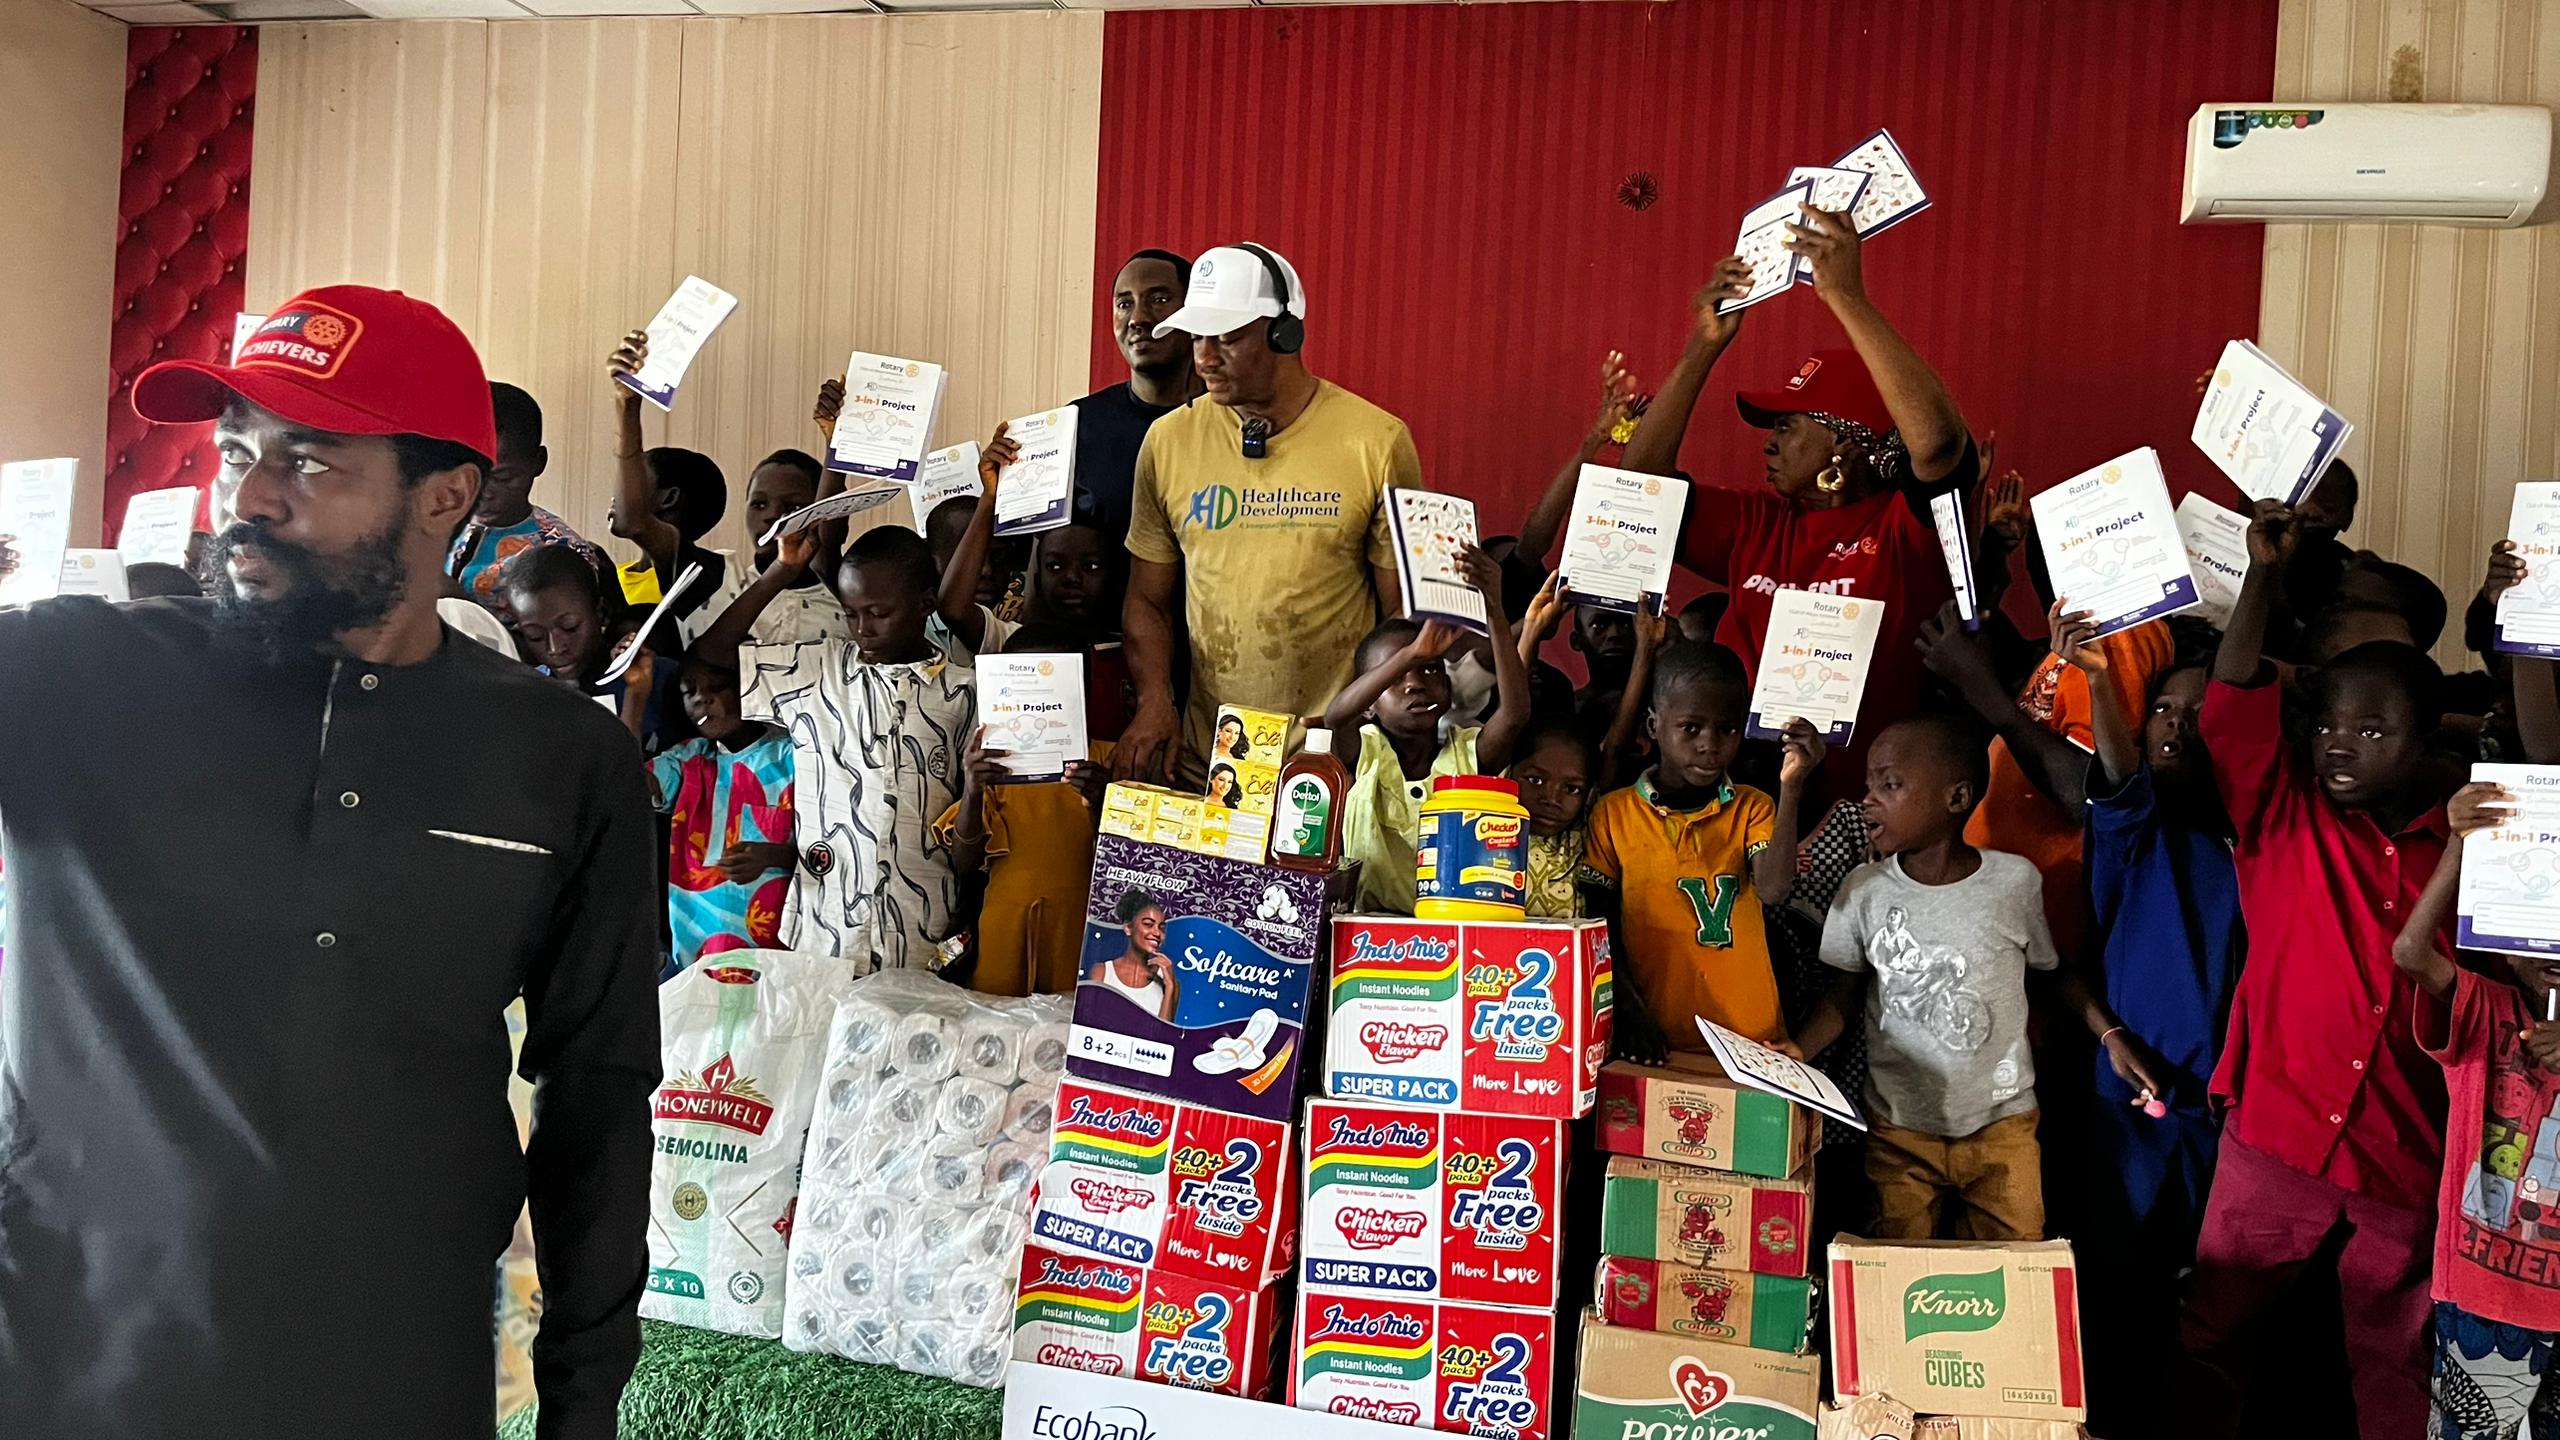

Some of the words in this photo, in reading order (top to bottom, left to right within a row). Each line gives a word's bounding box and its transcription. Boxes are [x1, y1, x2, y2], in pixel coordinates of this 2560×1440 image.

[240, 340, 330, 366] ACHIEVERS
[880, 362, 904, 373] Rotary
[854, 395, 880, 406] 3-in-1
[881, 399, 916, 412] Project
[2240, 388, 2266, 430] Project
[1025, 418, 1045, 429] Rotary
[926, 455, 947, 465] Rotary
[1030, 449, 1059, 462] Project
[1615, 476, 1643, 490] Rotary
[2068, 477, 2100, 497] Rotary
[921, 491, 942, 503] 3-in-1
[943, 483, 974, 497] Project
[1242, 487, 1341, 504] Healthcare
[1240, 503, 1339, 519] Development
[1586, 515, 1616, 528] 3-in-1
[1617, 520, 1657, 535] Project
[2059, 531, 2094, 552] 3-in-1
[2095, 511, 2145, 537] Project
[2522, 544, 2554, 556] 3-in-1
[2203, 555, 2243, 579] Project
[1813, 601, 1841, 615] Rotary
[1781, 645, 1812, 657] 3-in-1
[1813, 648, 1853, 662] Project
[1009, 664, 1036, 673] Rotary
[992, 703, 1020, 713] 3-in-1
[1023, 702, 1063, 712] Project
[2489, 831, 2534, 843] 3-in-1
[812, 850, 828, 867] 79
[1107, 865, 1149, 886] HEAVY
[1149, 874, 1188, 892] FLOW
[1677, 874, 1738, 948] V
[1244, 918, 1280, 934] COTTON
[1281, 925, 1303, 938] FEEL
[1177, 945, 1280, 986] Softcare
[1512, 951, 1552, 998] 2
[1219, 979, 1257, 998] Sanitary
[1258, 987, 1278, 1000] Pad
[1359, 983, 1391, 995] Instant
[1392, 984, 1430, 997] Noodles
[1468, 983, 1499, 995] packs
[1507, 998, 1549, 1011] packs
[1473, 1002, 1558, 1039] Free
[1363, 1021, 1444, 1048] Chicken
[1114, 1051, 1127, 1059] PCS
[1379, 1043, 1418, 1058] Flavor
[1497, 1041, 1544, 1055] Inside
[1340, 1076, 1394, 1096] SUPER
[1398, 1080, 1450, 1100] PACK
[1473, 1073, 1508, 1090] More
[657, 1095, 762, 1129] HONEYWELL
[657, 1135, 748, 1164] SEMOLINA
[1674, 1144, 1704, 1157] Gino
[1069, 1148, 1100, 1163] Instant
[1101, 1153, 1138, 1170] Noodles
[1217, 1141, 1257, 1185] 2
[1492, 1142, 1532, 1189] 2
[1175, 1165, 1206, 1176] packs
[1336, 1169, 1369, 1182] Instant
[1370, 1170, 1409, 1185] Noodles
[1448, 1173, 1480, 1183] packs
[1073, 1178, 1151, 1209] Chicken
[1212, 1182, 1253, 1196] packs
[1488, 1188, 1530, 1201] packs
[1179, 1182, 1259, 1217] Free
[1687, 1193, 1719, 1204] Gino
[1453, 1193, 1538, 1228] Free
[1198, 1213, 1242, 1234] Inside
[1337, 1207, 1421, 1234] Chicken
[1043, 1216, 1094, 1244] SUPER
[1097, 1231, 1146, 1259] PACK
[1355, 1229, 1395, 1244] Flavor
[1478, 1231, 1524, 1246] Inside
[1167, 1239, 1202, 1260] More
[1315, 1263, 1370, 1282] SUPER
[1375, 1268, 1429, 1288] PACK
[1451, 1262, 1488, 1279] More
[664, 1276, 675, 1290] X
[681, 1279, 699, 1294] 10
[1908, 1289, 1999, 1317] Knorr
[1041, 1305, 1072, 1321] Instant
[1073, 1310, 1110, 1327] Noodles
[1188, 1295, 1227, 1341] 2
[1147, 1320, 1177, 1331] packs
[1687, 1321, 1721, 1335] Gino
[1181, 1338, 1222, 1353] packs
[1925, 1349, 1962, 1360] SEASONING
[1040, 1346, 1117, 1376] Chicken
[1148, 1341, 1228, 1379] Free
[1330, 1357, 1363, 1372] Instant
[1364, 1360, 1404, 1375] Noodles
[1486, 1336, 1530, 1383] 2
[1442, 1366, 1474, 1377] packs
[1925, 1360, 1985, 1388] CUBES
[1481, 1383, 1525, 1397] packs
[1331, 1397, 1414, 1425] Chicken
[1448, 1386, 1533, 1422] Free
[1033, 1404, 1157, 1440] Ecobank
[1885, 1411, 1912, 1430] KILLS
[1470, 1424, 1517, 1440] Inside
